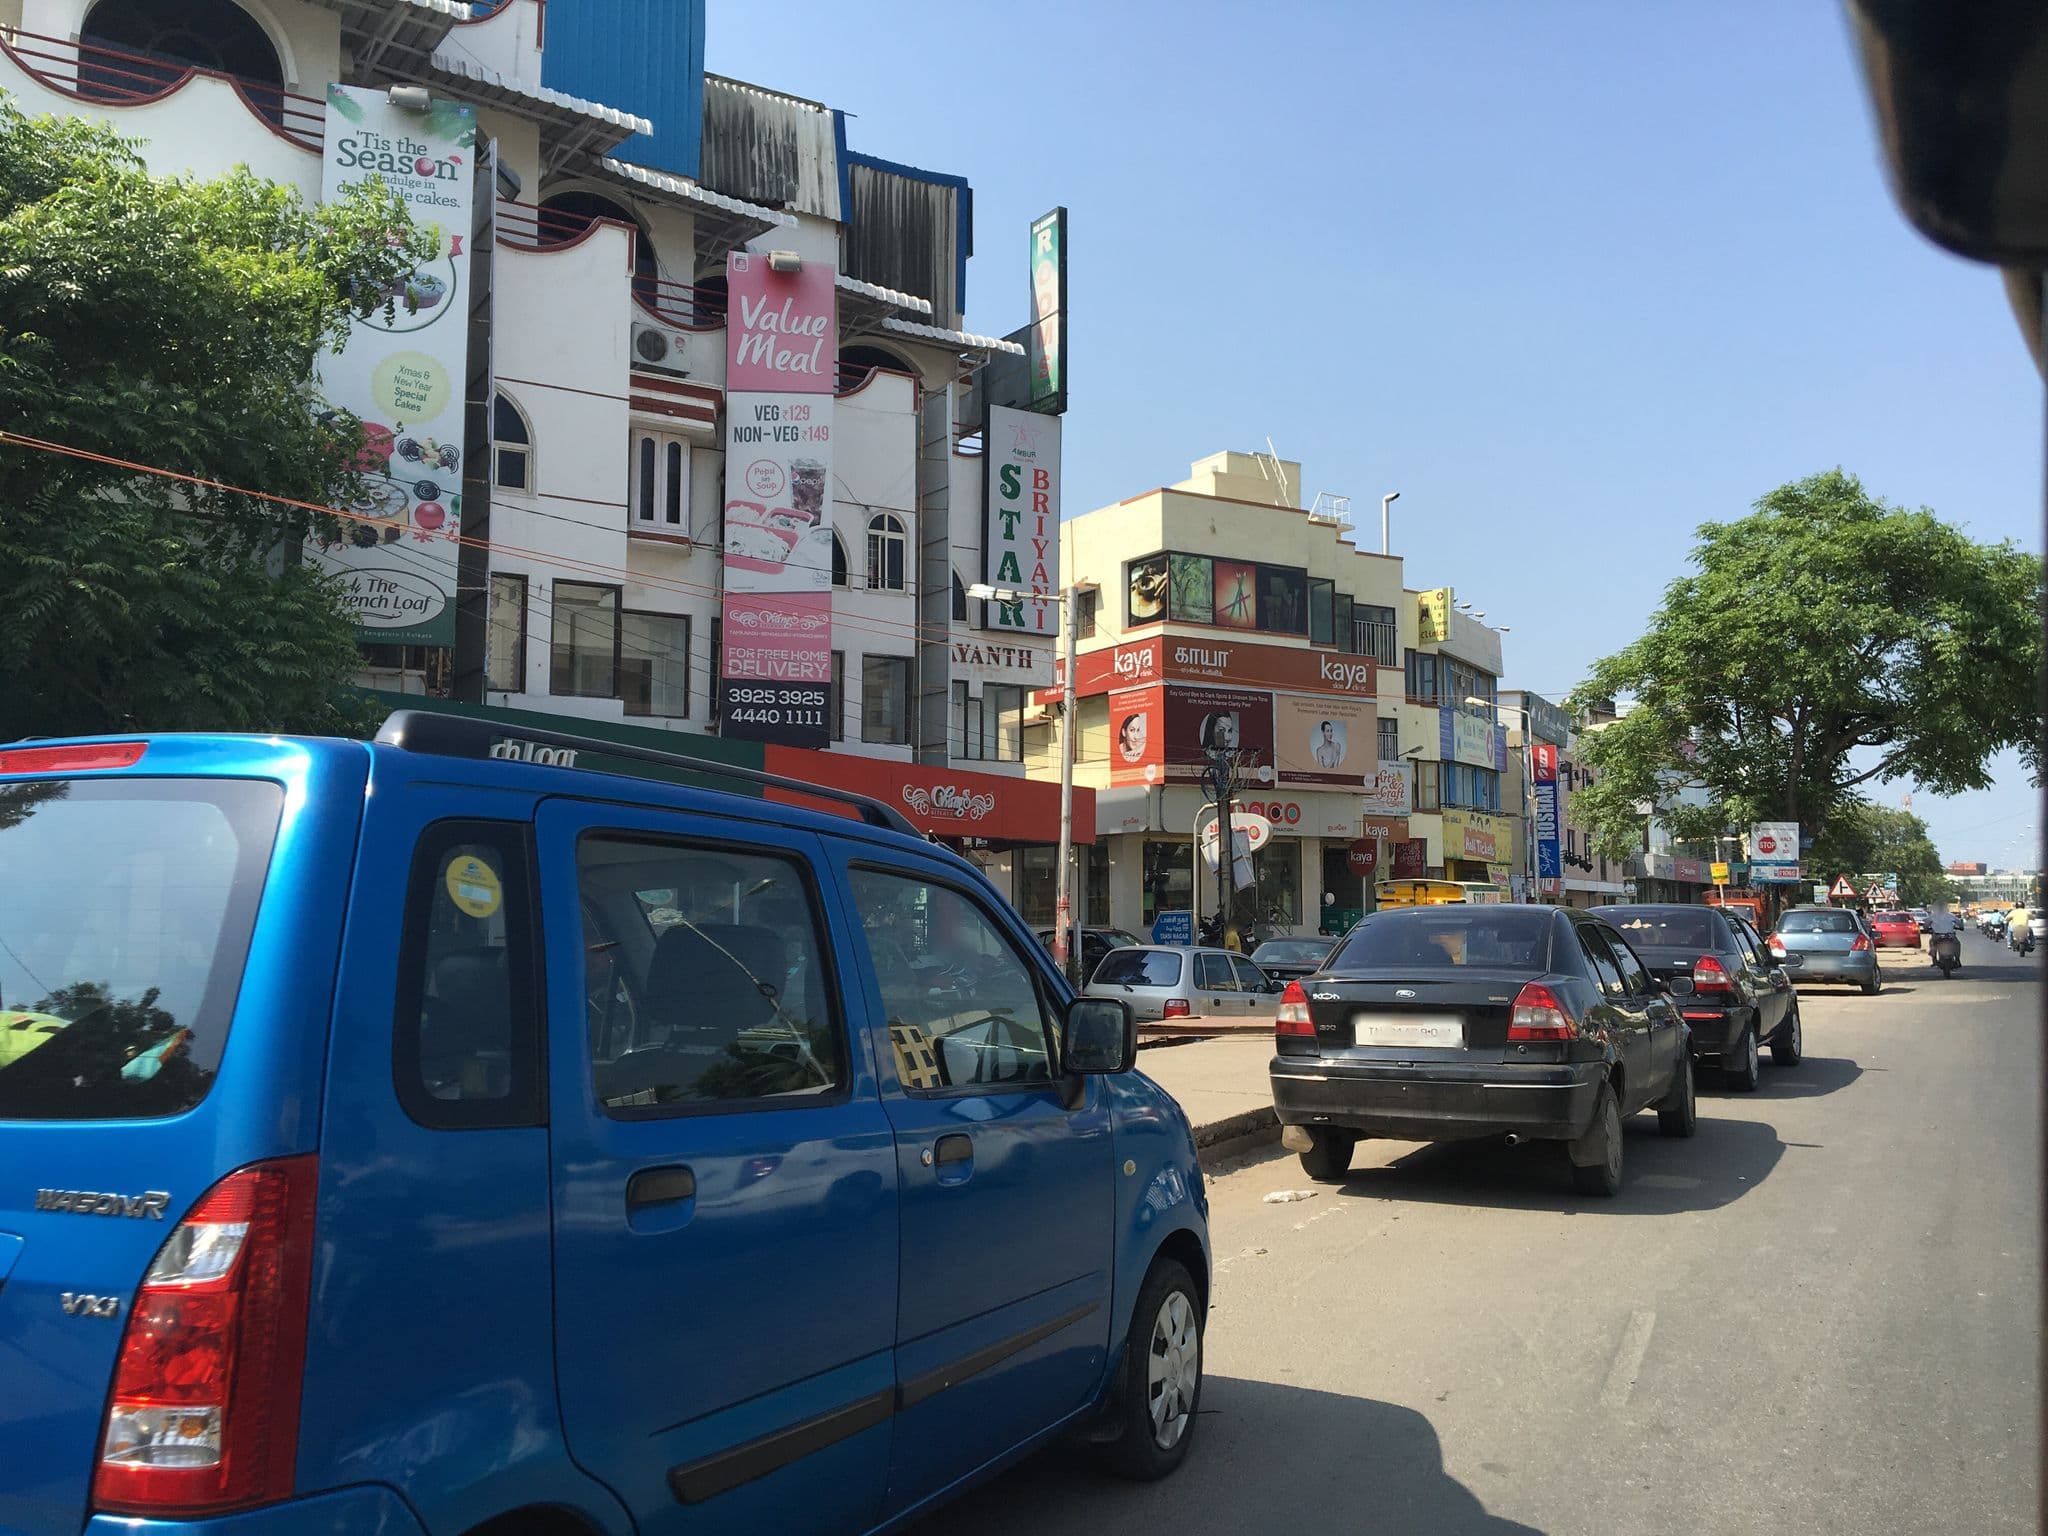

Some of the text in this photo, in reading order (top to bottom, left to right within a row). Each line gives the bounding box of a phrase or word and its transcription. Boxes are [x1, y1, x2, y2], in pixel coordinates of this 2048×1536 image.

[356, 129, 428, 156] 'Tis the
[336, 138, 460, 181] Season
[424, 178, 436, 189] in
[415, 190, 461, 208] cakes.
[740, 294, 829, 338] Value
[736, 333, 824, 375] Meal
[398, 364, 431, 380] Xmas &
[393, 375, 433, 392] New Year
[394, 386, 427, 402] Special
[394, 398, 422, 412] Cakes
[754, 404, 780, 422] VEG
[733, 425, 799, 443] NON-VEG
[1011, 447, 1037, 458] AMBUR
[756, 482, 777, 491] Soup
[1031, 466, 1050, 630] BRIYANI
[367, 578, 399, 594] The
[340, 594, 432, 615] rench Loaf
[728, 647, 828, 662] FOR FREE HOME
[1114, 647, 1153, 678] kaya
[727, 658, 829, 679] DELIVERY
[1320, 653, 1367, 690] kaya
[728, 688, 825, 706] 3925 3925
[731, 708, 823, 726] 4440 1111
[1536, 785, 1556, 841] ROSHAN
[1364, 822, 1389, 839] kaya
[1760, 841, 1776, 849] STOP
[1350, 850, 1373, 864] kaya
